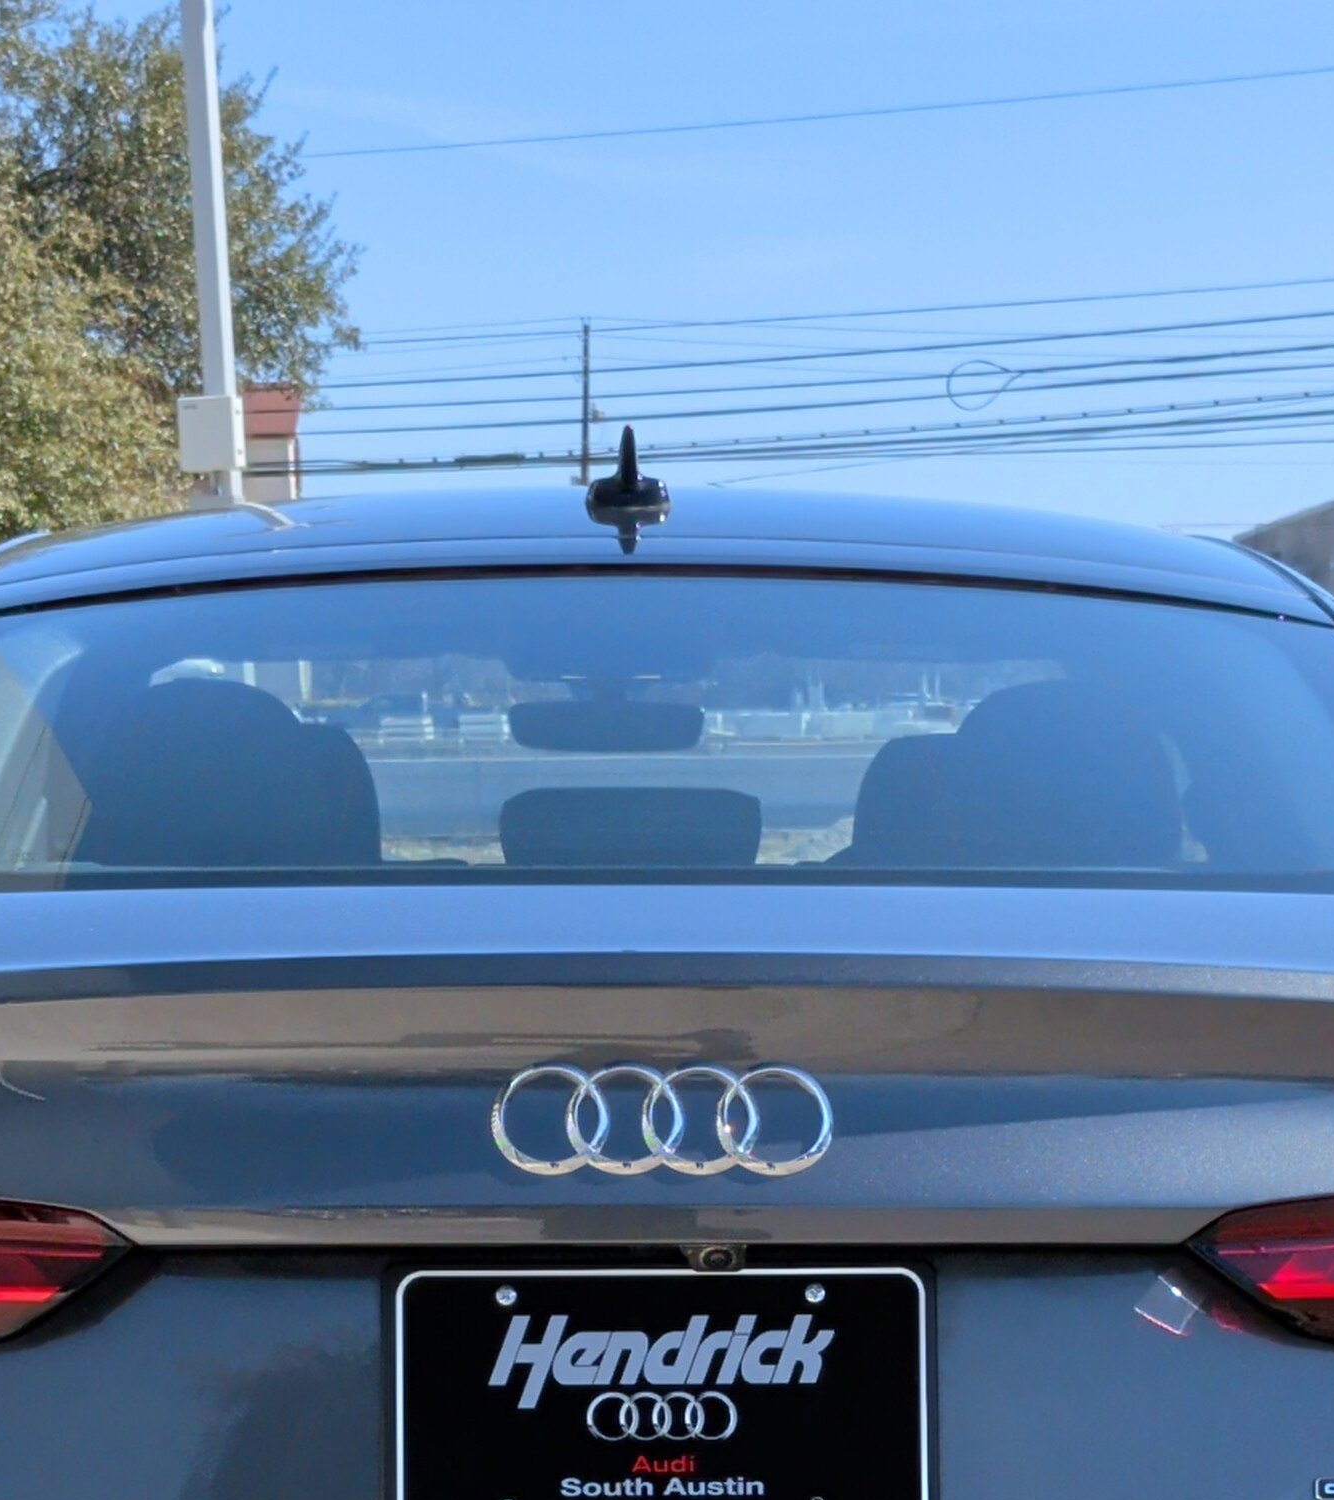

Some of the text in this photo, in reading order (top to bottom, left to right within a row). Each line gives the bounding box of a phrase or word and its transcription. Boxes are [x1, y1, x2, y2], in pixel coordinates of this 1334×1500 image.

[488, 1314, 836, 1409] Hendrick
[631, 1454, 697, 1474] Audi
[559, 1476, 766, 1498] South Austin
